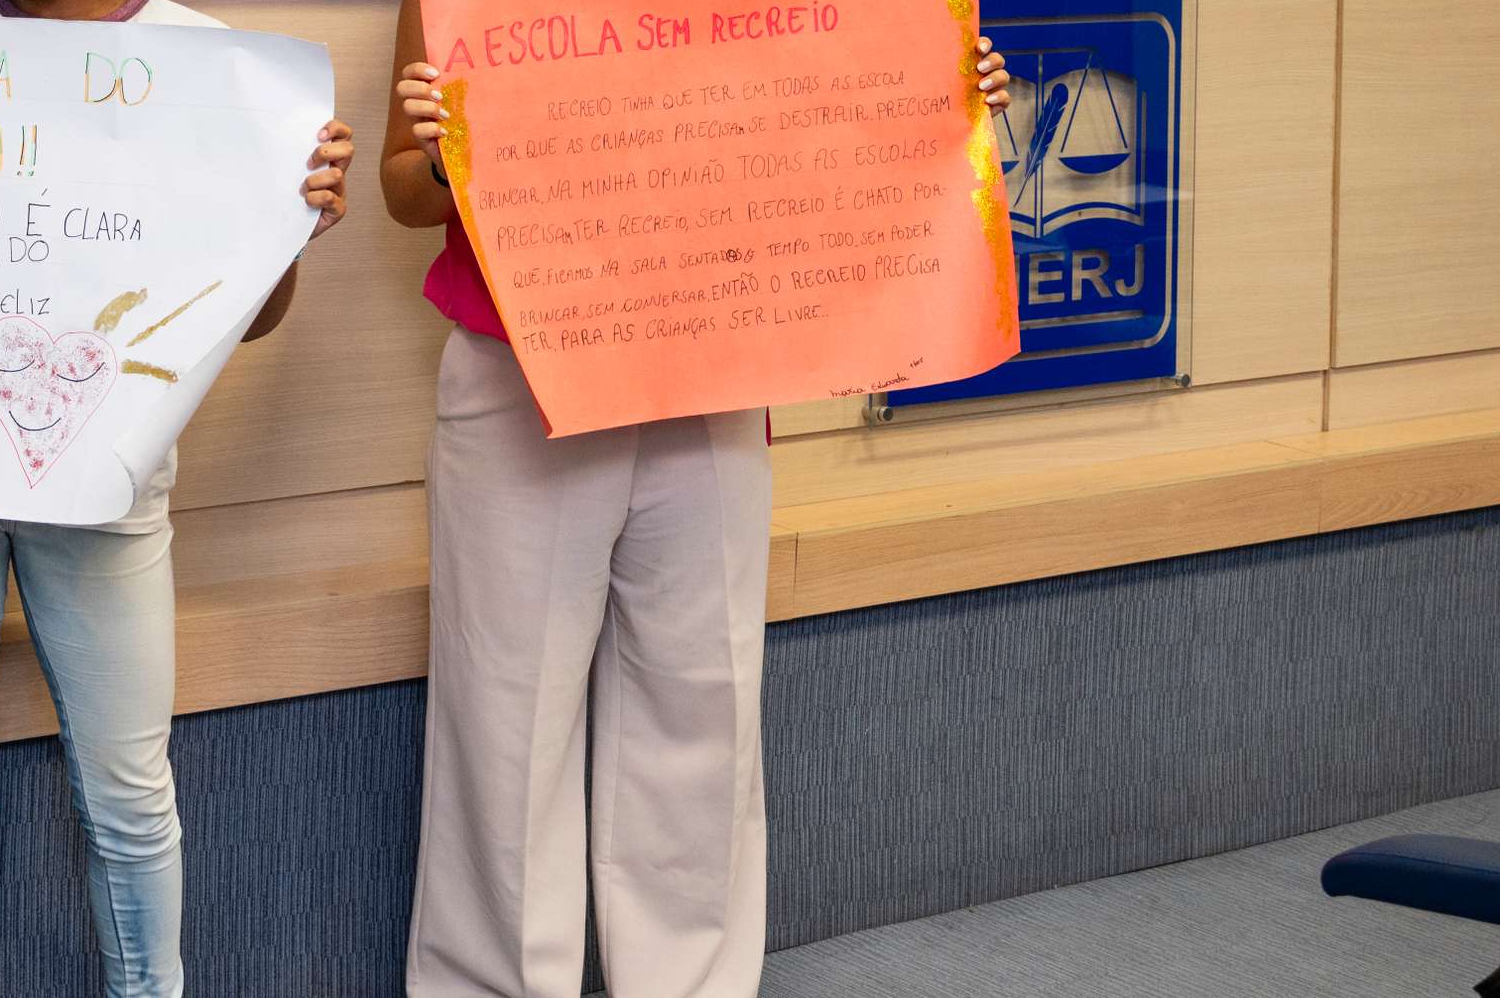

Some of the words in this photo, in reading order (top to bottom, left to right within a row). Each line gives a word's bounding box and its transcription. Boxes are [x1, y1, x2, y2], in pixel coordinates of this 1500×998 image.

[444, 38, 474, 72] A
[485, 15, 622, 68] ESCOLA
[637, 13, 690, 51] SEM
[711, 1, 839, 44] RECREIO
[84, 52, 152, 106] DO
[548, 96, 612, 121] RECREIO
[621, 96, 654, 114] TINHA
[662, 89, 693, 110] QUE
[700, 85, 735, 105] TER
[743, 81, 767, 100] EM
[772, 76, 820, 98] TODAS
[831, 74, 850, 91] AS
[858, 71, 904, 89] ESCOLA
[496, 145, 521, 162] POR
[526, 137, 557, 159] QUE
[566, 137, 584, 154] AS
[590, 128, 664, 152] CRIANÇAS
[877, 95, 951, 121] PRECISAM
[547, 179, 573, 203] NA
[582, 172, 637, 199] MINHA
[648, 158, 725, 190] OPINIÃO
[738, 151, 803, 180] TODAS
[815, 148, 839, 172] AS
[855, 139, 938, 167] ESCOLAS
[26, 188, 51, 236] É
[63, 207, 141, 241] CLARA
[573, 218, 610, 242] TER
[698, 207, 733, 229] SEM
[748, 193, 825, 223] RECREIO
[834, 186, 844, 211] É
[853, 184, 903, 210] CHATO
[9, 236, 50, 263] DO
[600, 258, 619, 278] NA
[631, 256, 667, 274] SALA
[767, 237, 810, 257] TEMPO
[861, 230, 885, 246] SEM
[891, 220, 934, 242] PODER
[1016, 245, 1145, 305] ERJ
[587, 302, 614, 318] SEM
[711, 272, 759, 301] ENTÃO
[771, 274, 780, 293] O
[791, 264, 866, 290] RECREIO
[875, 253, 941, 280] PRECISA
[561, 329, 604, 351] PARA
[613, 322, 635, 343] AS
[646, 316, 716, 340] CRIANÇAS
[729, 306, 766, 330] SER
